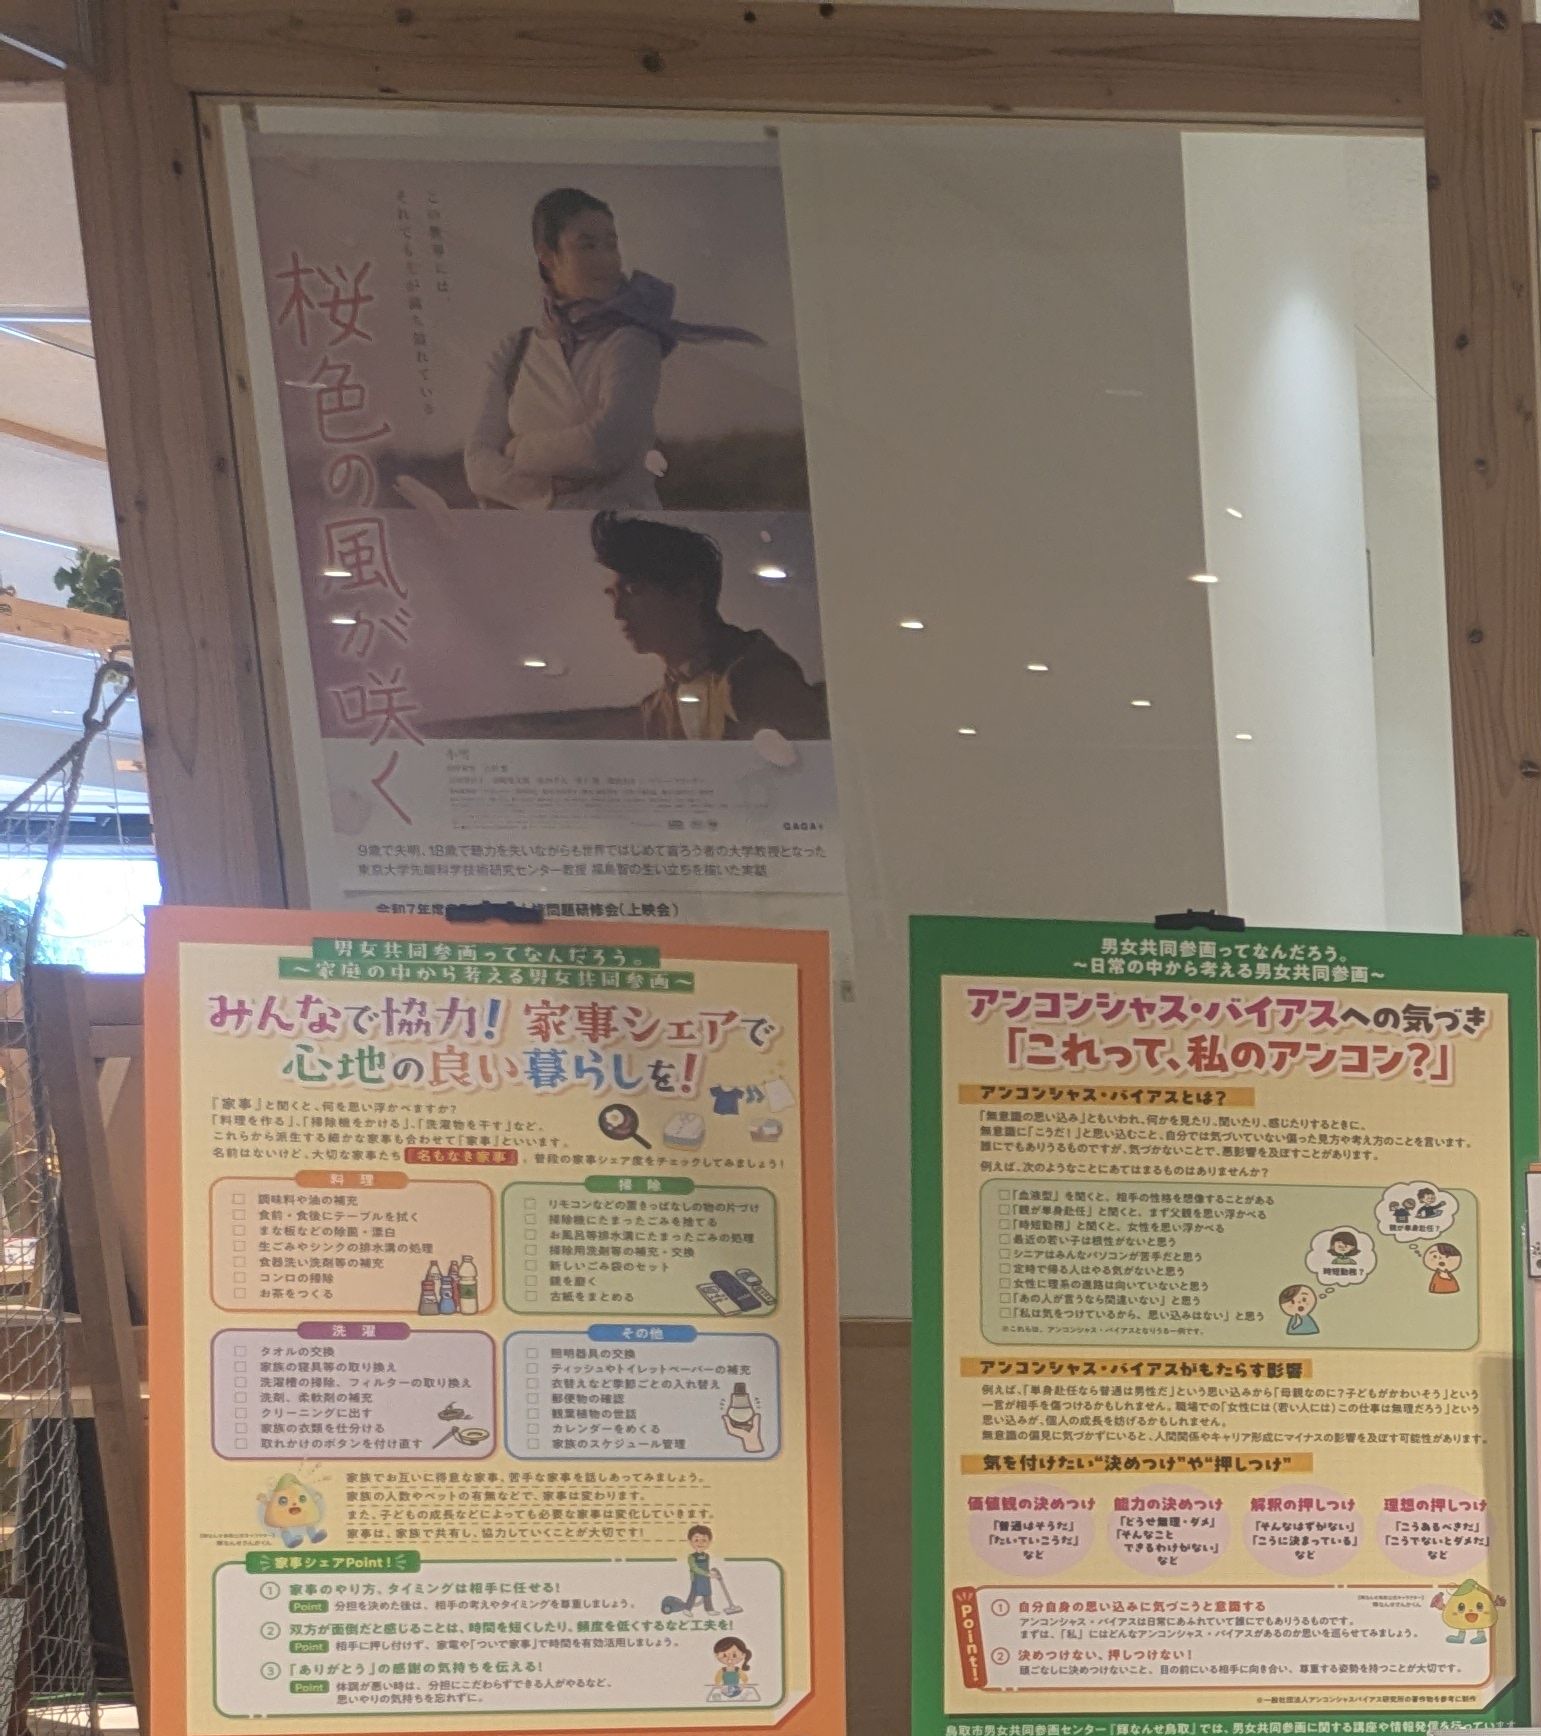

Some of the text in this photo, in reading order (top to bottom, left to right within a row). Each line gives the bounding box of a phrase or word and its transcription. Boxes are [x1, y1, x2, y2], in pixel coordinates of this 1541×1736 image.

[276, 252, 425, 825] 桜色の風が咲く
[1101, 938, 1348, 964] 男女共同参画ってなんだろう。
[967, 987, 1488, 1035] アンコンシャス・バイアスへの気づき
[622, 1327, 665, 1340] その他
[261, 1347, 335, 1358] タオルの交換
[261, 1408, 373, 1419] クリーニングに出す
[552, 1423, 661, 1435] カレンダーをめくる
[552, 1438, 686, 1449] 家族のスケジュール管理
[967, 1496, 1097, 1512] 価値観の決めつけ
[1114, 1497, 1224, 1512] 能力の決めつけ
[1250, 1498, 1356, 1512] 解釈の押しつけ
[1383, 1498, 1488, 1512] 理想の押しつけ
[1395, 1521, 1480, 1533] 「こうあるべきだ」
[988, 1535, 1079, 1547] 「たいていこうだ」
[294, 1602, 322, 1611] Point
